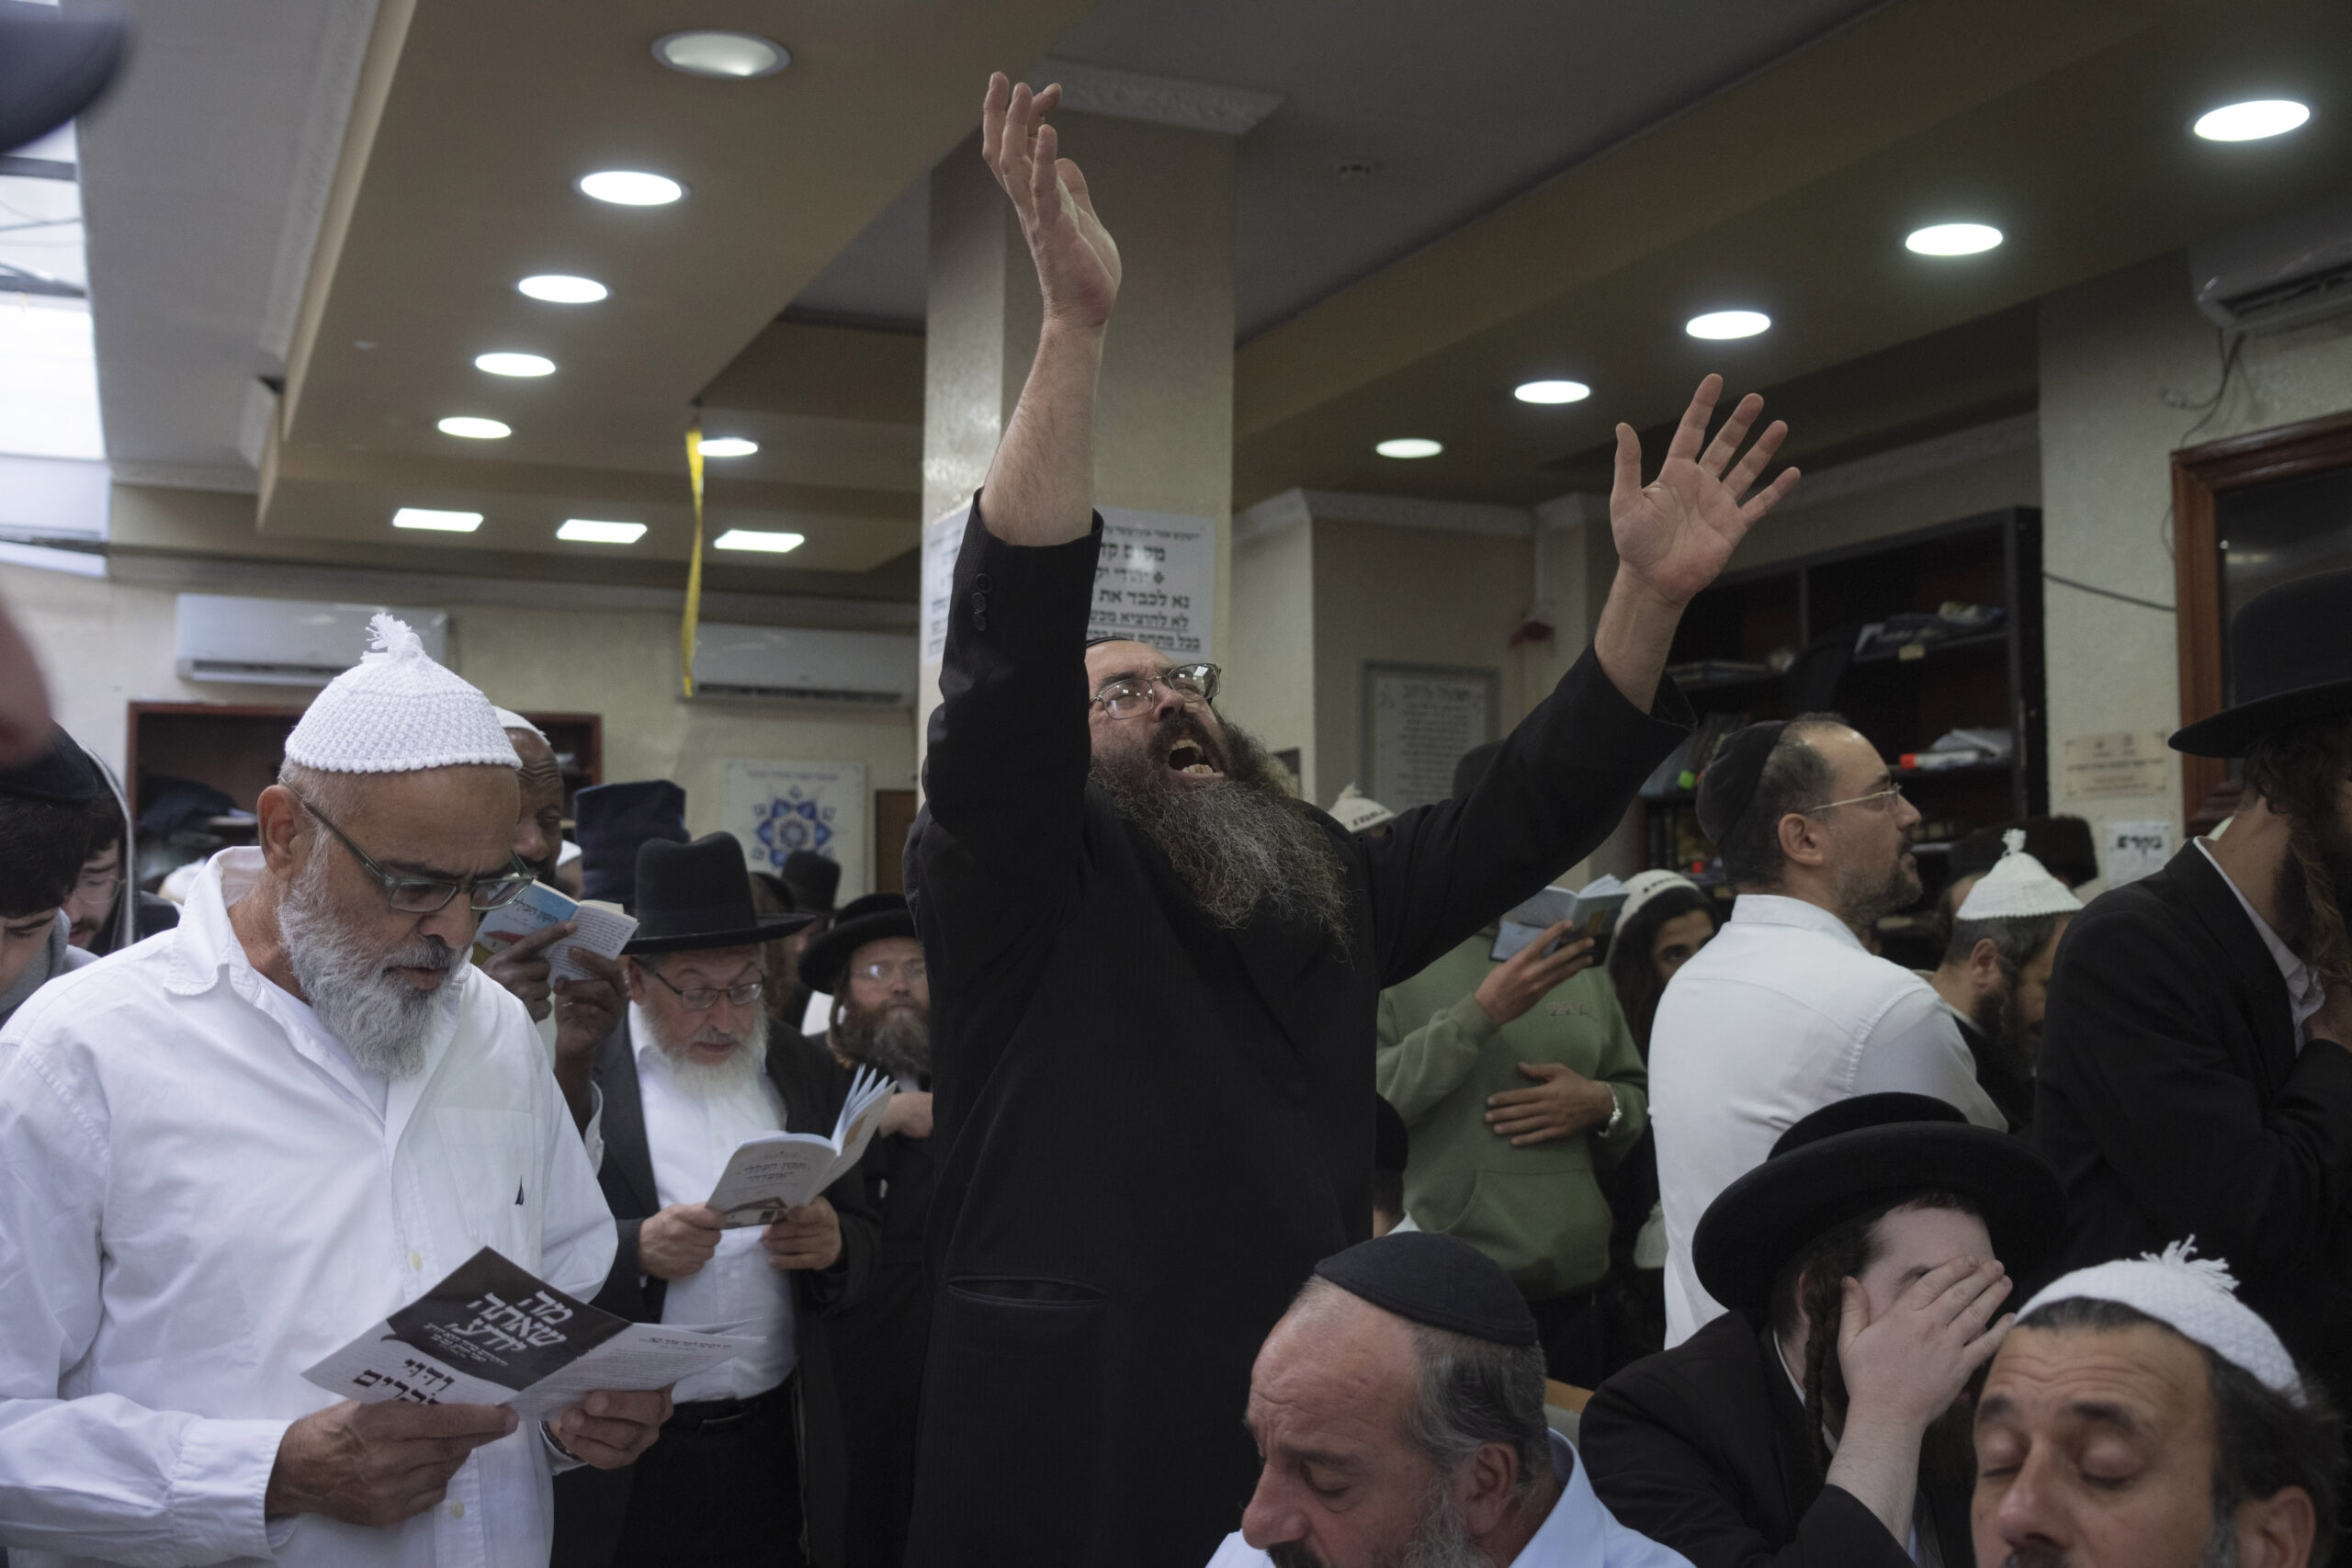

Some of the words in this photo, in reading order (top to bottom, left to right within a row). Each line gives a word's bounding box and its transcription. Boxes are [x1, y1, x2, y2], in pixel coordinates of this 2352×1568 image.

[1100, 590, 1123, 604] את
[1171, 594, 1191, 609] נא
[1171, 612, 1189, 628] לא
[466, 1292, 567, 1347] שאתה
[517, 1291, 573, 1325] מה
[352, 1369, 440, 1404] ברים
